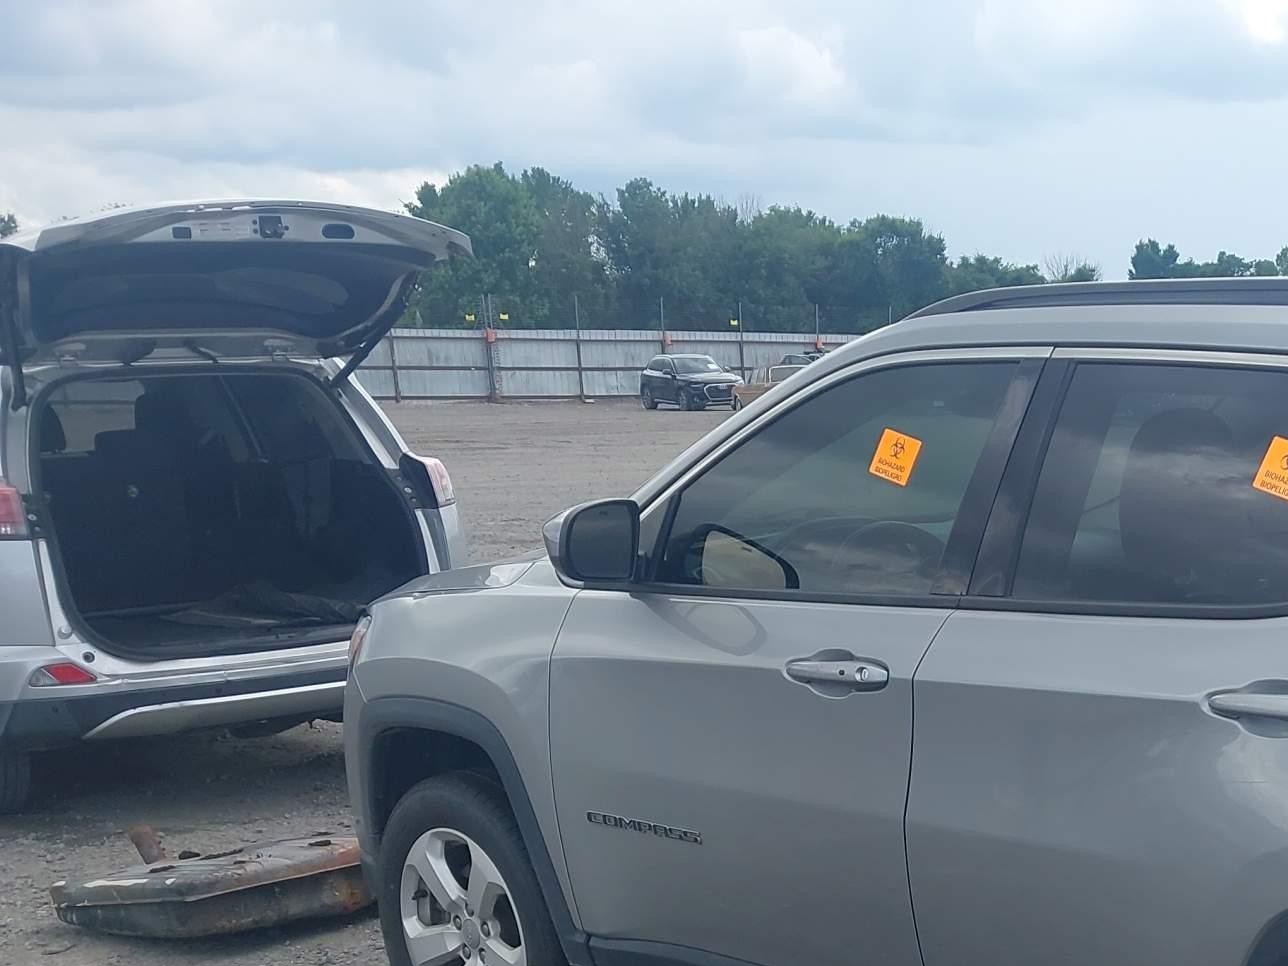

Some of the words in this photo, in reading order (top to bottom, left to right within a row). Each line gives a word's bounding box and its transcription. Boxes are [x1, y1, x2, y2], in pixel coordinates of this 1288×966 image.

[878, 457, 905, 473] BIOHAZARD
[874, 466, 902, 481] BIOPELIGRO
[586, 809, 703, 845] COMPASS
